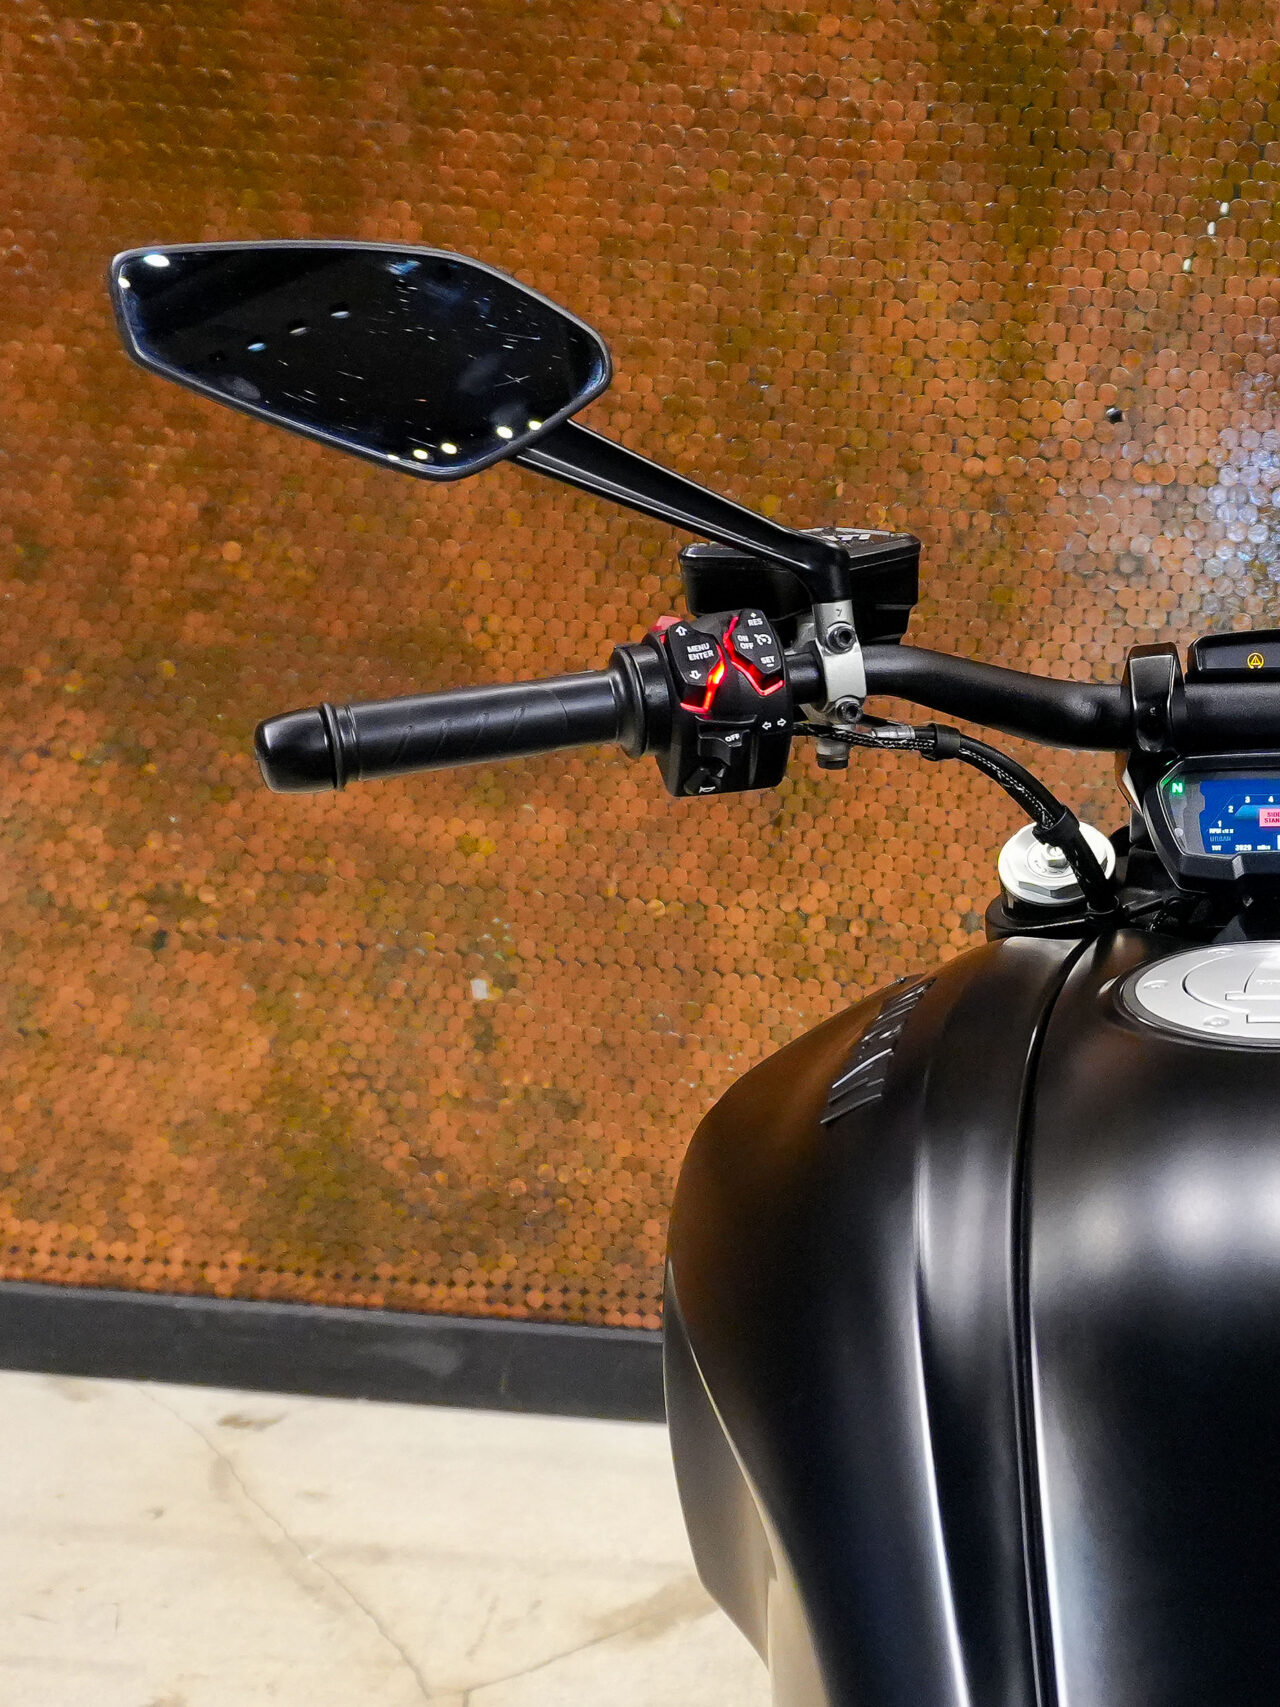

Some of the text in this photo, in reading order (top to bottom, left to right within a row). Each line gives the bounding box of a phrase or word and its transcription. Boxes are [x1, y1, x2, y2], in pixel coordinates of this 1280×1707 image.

[748, 618, 763, 627] RES
[687, 643, 710, 653] MENU
[688, 651, 715, 661] ENTER
[761, 656, 775, 664] SET
[725, 734, 740, 742] OFF
[1173, 783, 1183, 793] N
[1245, 796, 1251, 804] 3
